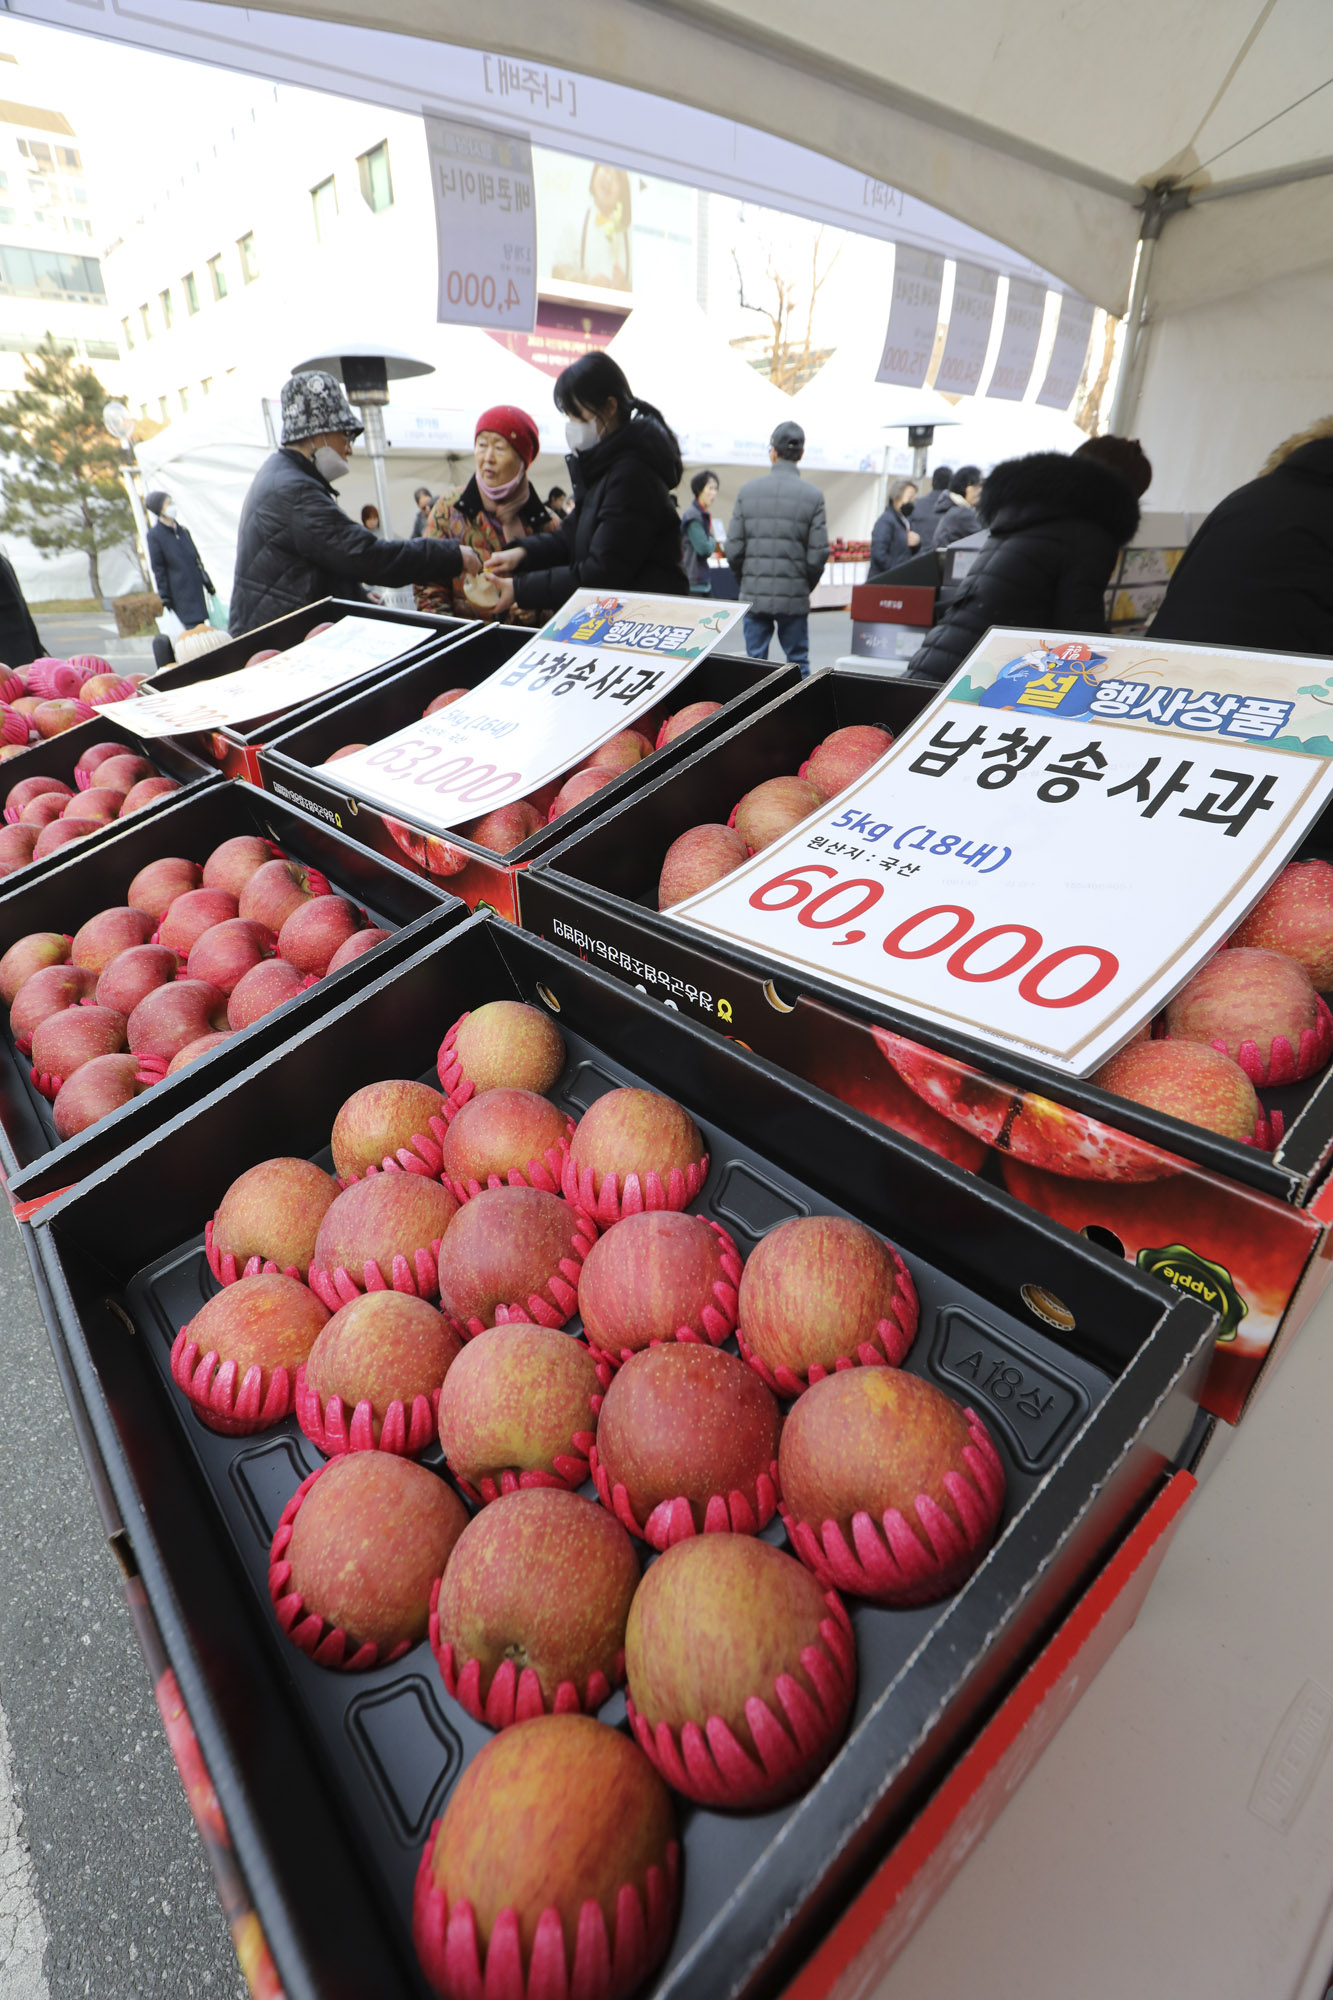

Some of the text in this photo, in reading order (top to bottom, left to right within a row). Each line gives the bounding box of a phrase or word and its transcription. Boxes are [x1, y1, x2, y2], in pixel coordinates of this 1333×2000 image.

[570, 617, 694, 651] 설 행사상품
[499, 649, 665, 706] 남청송사과
[1016, 672, 1292, 740] 설 행사상품
[440, 709, 471, 727] 5kg
[366, 740, 522, 803] 63,000
[908, 721, 1279, 837] 남청송사과
[831, 809, 1013, 874] 5kg (18내)
[879, 856, 921, 877] 국산
[553, 918, 714, 1012] 청송군농협조합공동사업법인
[748, 864, 1120, 1009] 60,000
[1163, 1266, 1217, 1302] Apple
[955, 1350, 1055, 1421] A18상
